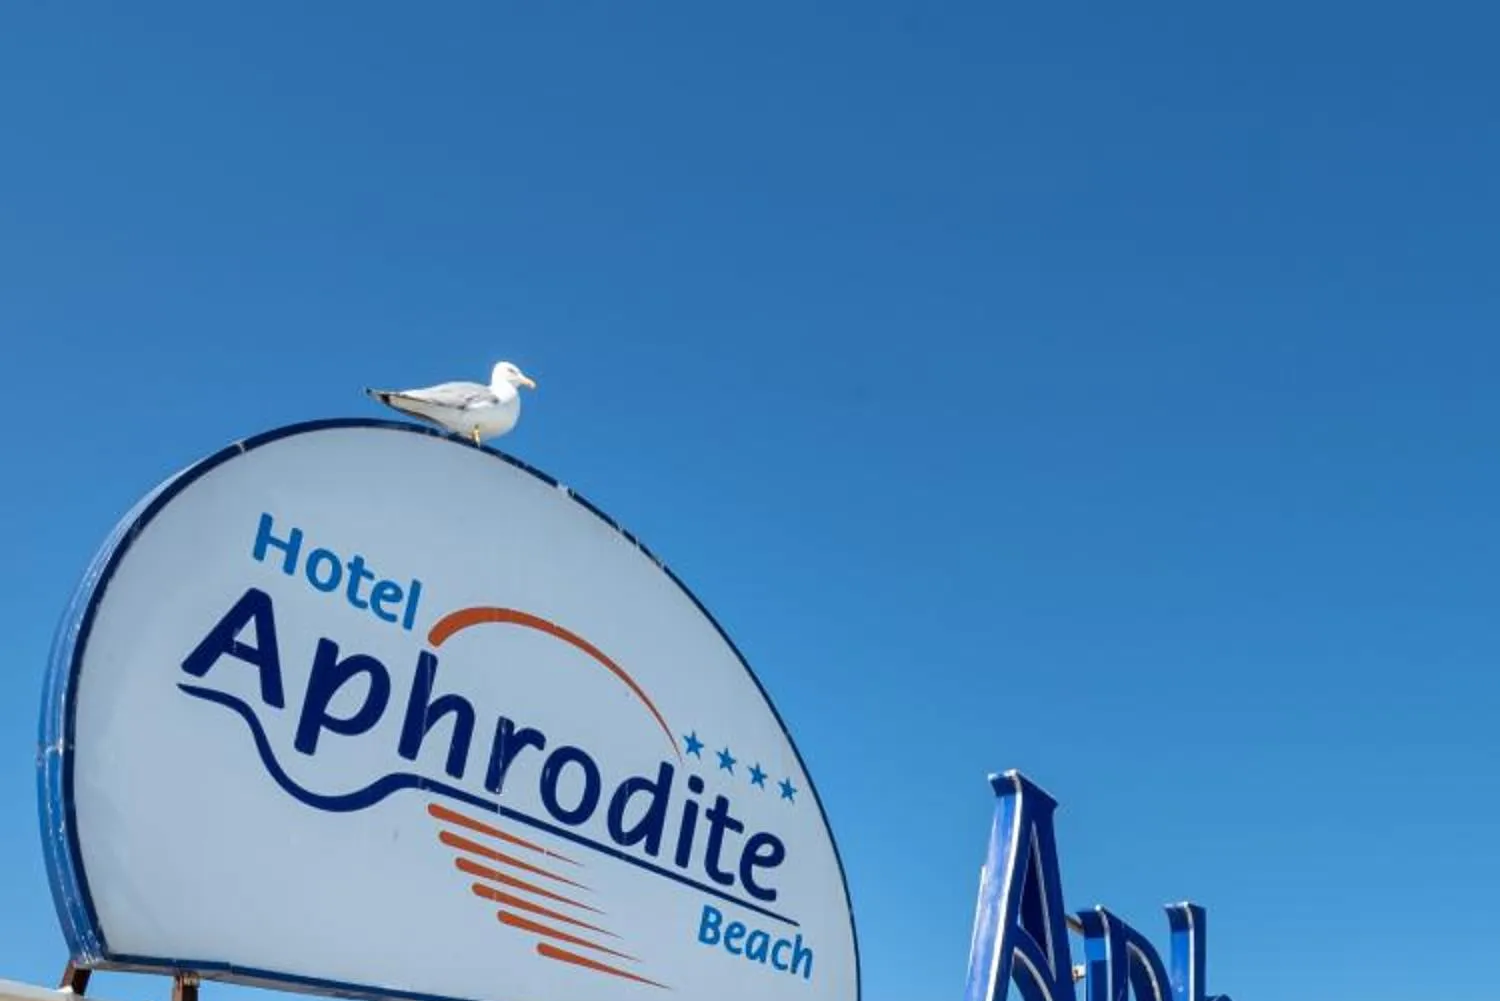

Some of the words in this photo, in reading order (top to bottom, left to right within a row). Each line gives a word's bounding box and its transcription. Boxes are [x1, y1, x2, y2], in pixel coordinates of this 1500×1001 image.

[252, 513, 422, 631] Hotel
[180, 587, 786, 902] Aphrodite
[698, 904, 814, 979] Beach
